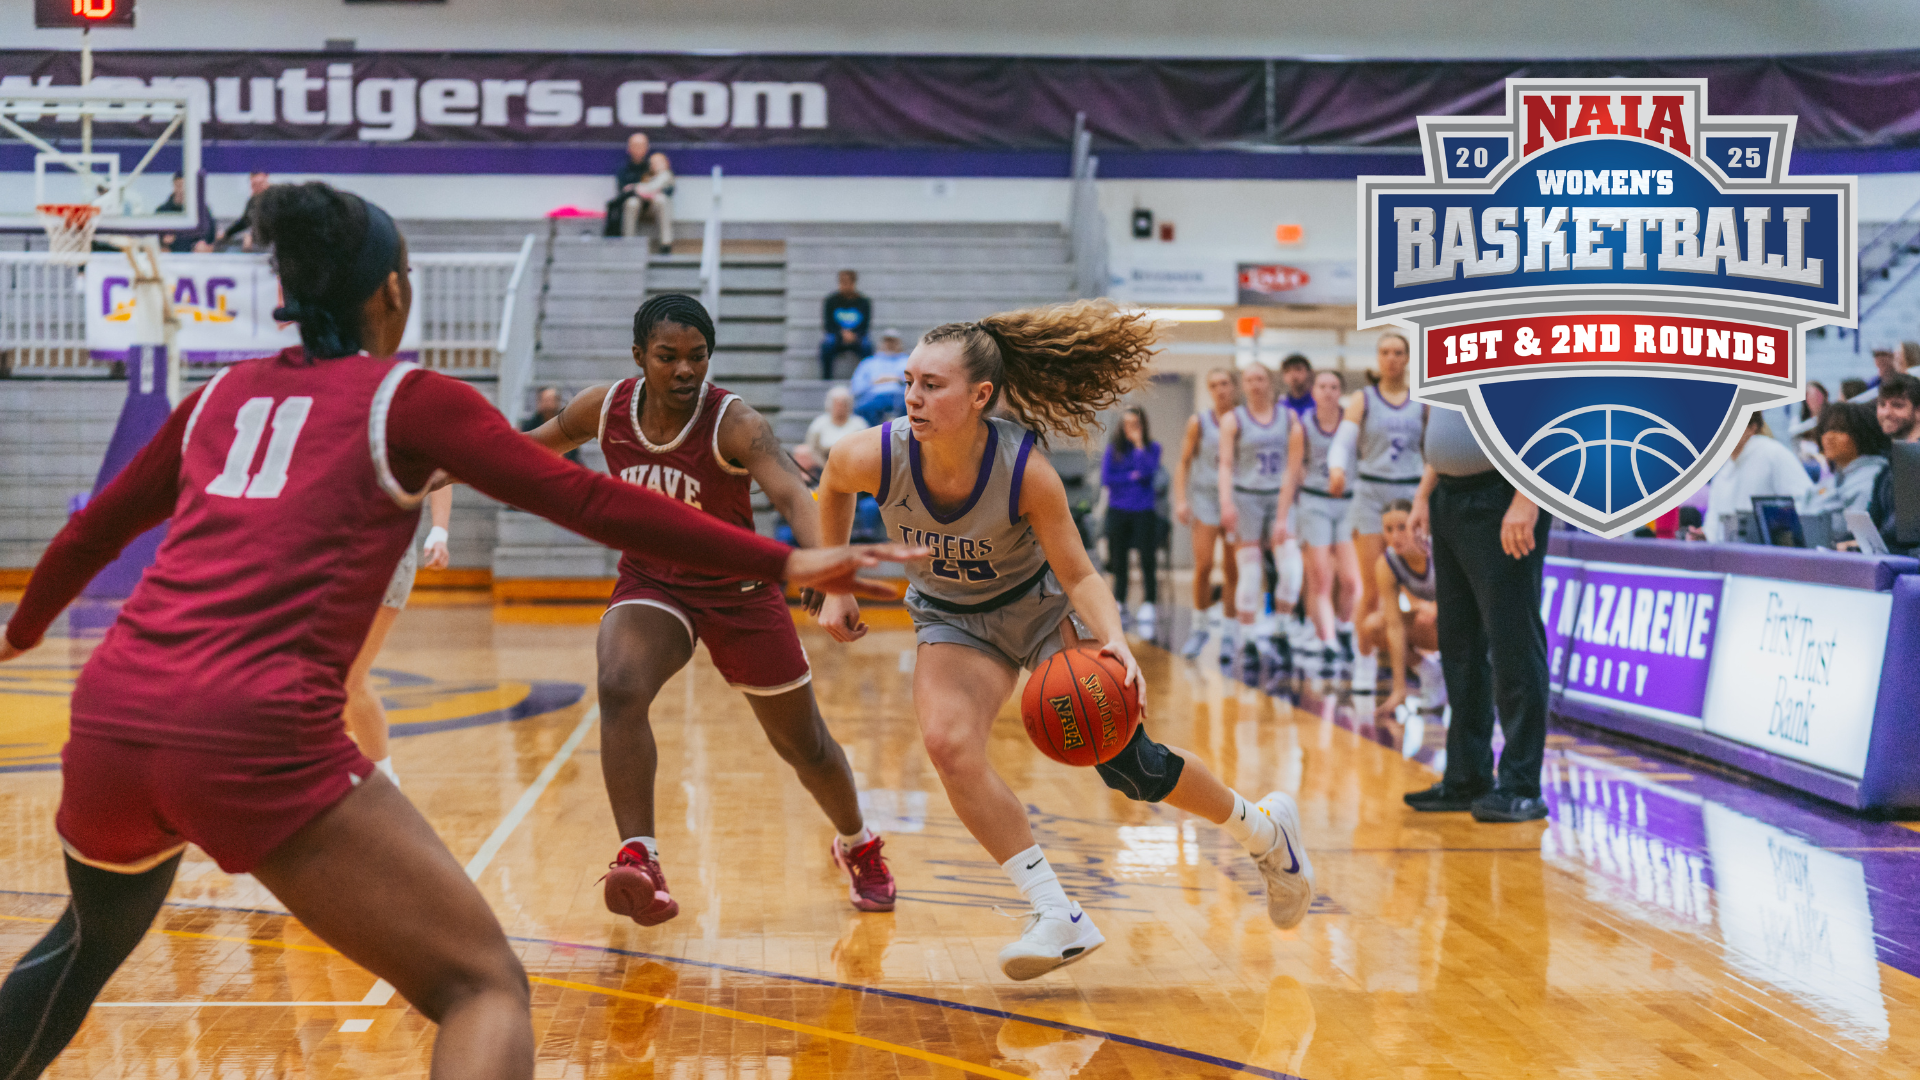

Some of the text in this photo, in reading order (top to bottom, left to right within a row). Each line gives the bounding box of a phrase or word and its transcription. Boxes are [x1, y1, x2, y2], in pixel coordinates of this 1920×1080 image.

[102, 276, 237, 321] CAC
[205, 396, 313, 498] 11
[620, 464, 702, 511] WAVE
[898, 523, 994, 559] TIGERS
[1556, 578, 1714, 660] NAZARENE
[1760, 591, 1838, 686] First Trust
[1048, 695, 1086, 750] NAIA
[1080, 673, 1118, 750] SPALDING
[1768, 675, 1816, 746] Bank
